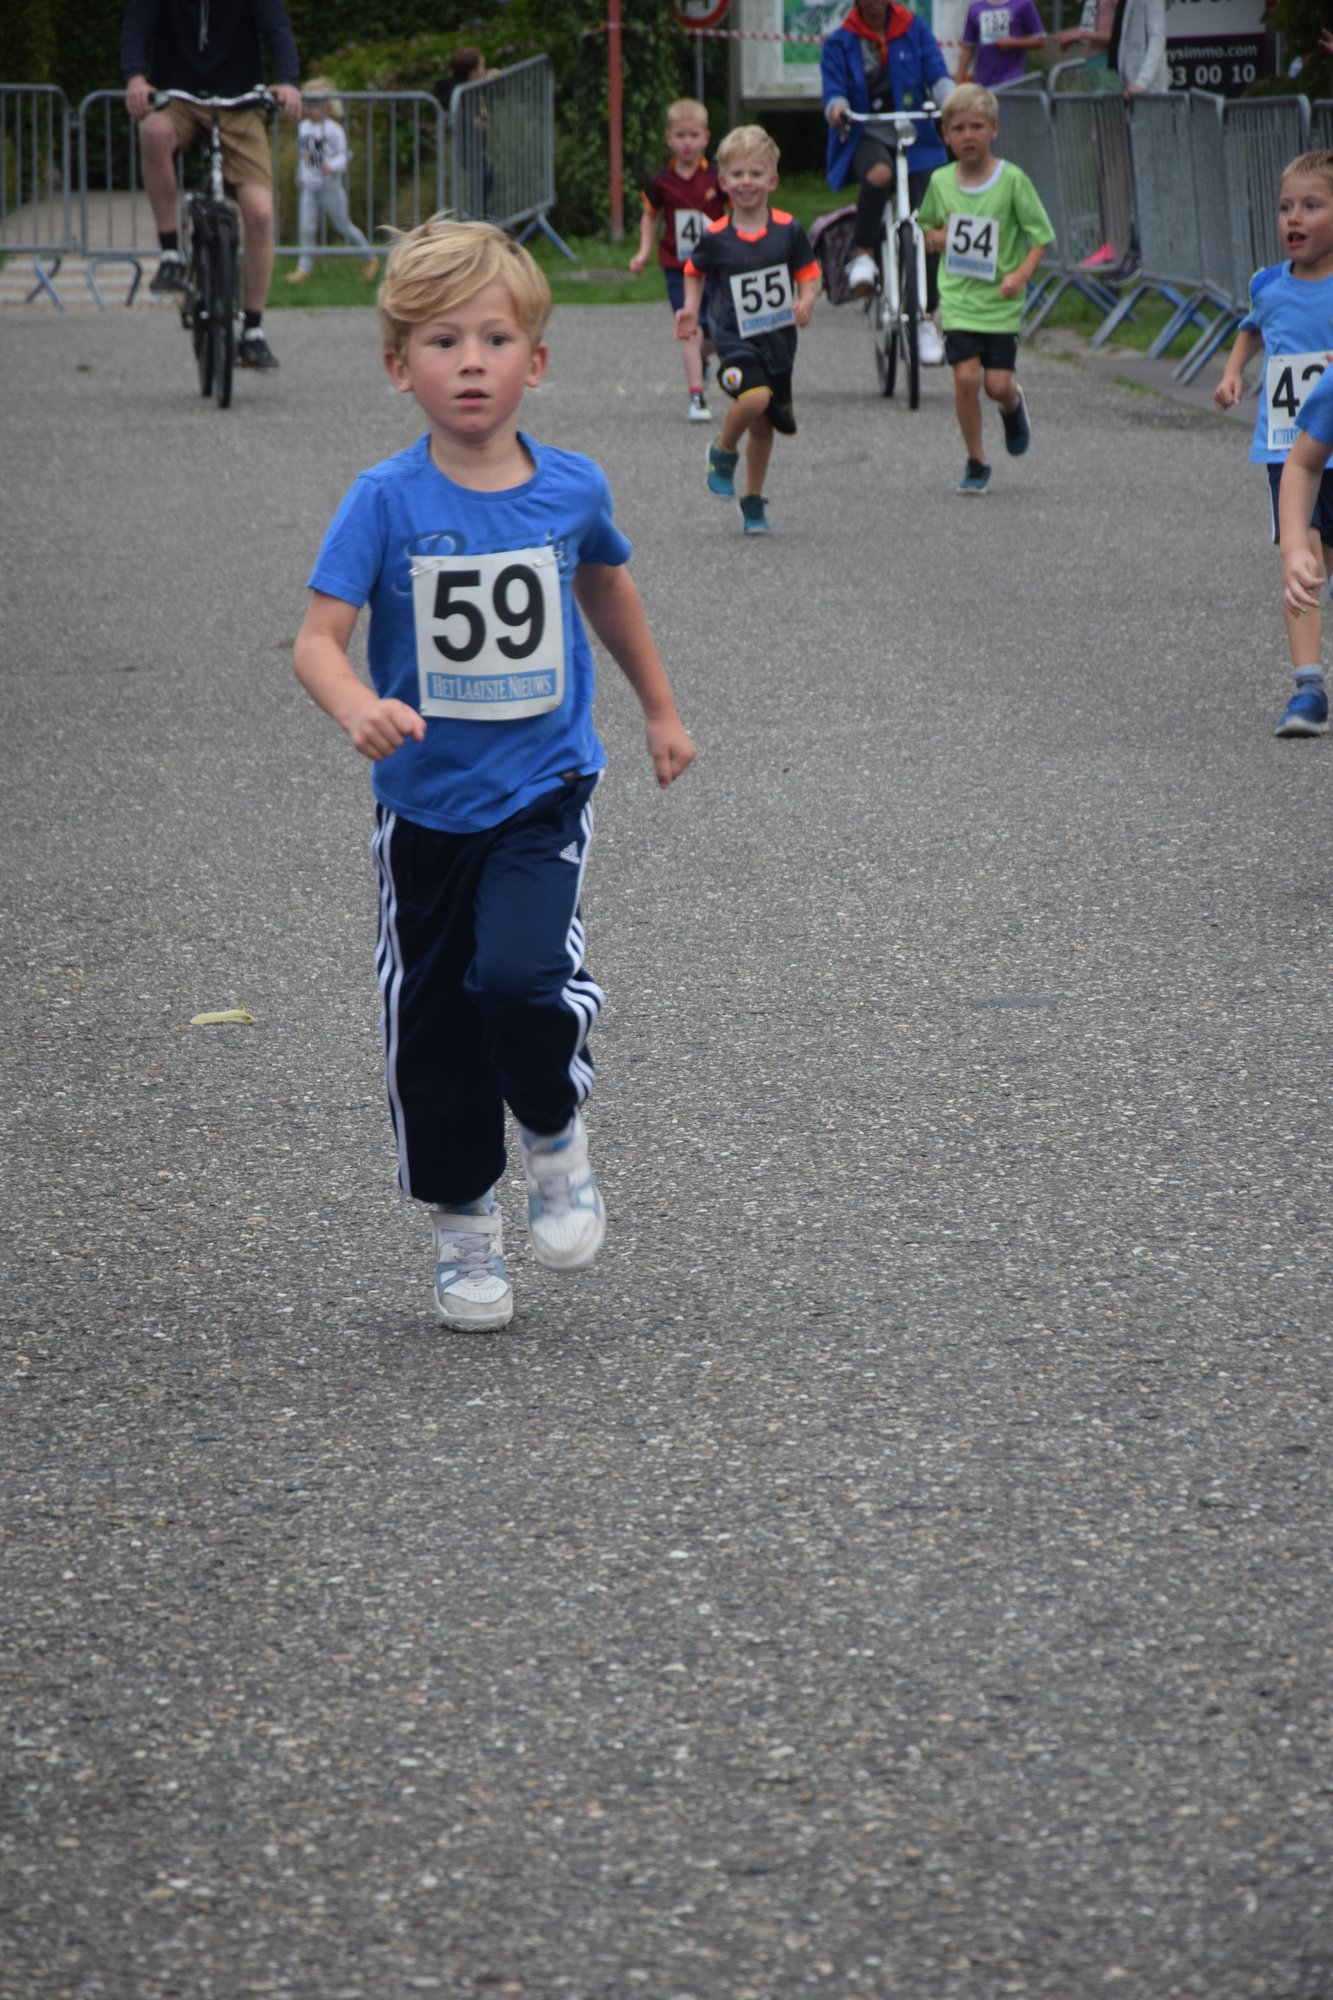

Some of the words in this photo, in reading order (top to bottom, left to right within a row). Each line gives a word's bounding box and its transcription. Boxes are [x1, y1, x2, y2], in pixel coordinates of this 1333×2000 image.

[1195, 64, 1222, 85] 00
[1231, 62, 1256, 83] 10
[952, 218, 993, 258] 54
[741, 269, 786, 314] 55
[432, 563, 545, 663] 59
[456, 677, 507, 700] LAATSTE
[508, 675, 552, 699] NIEUWS
